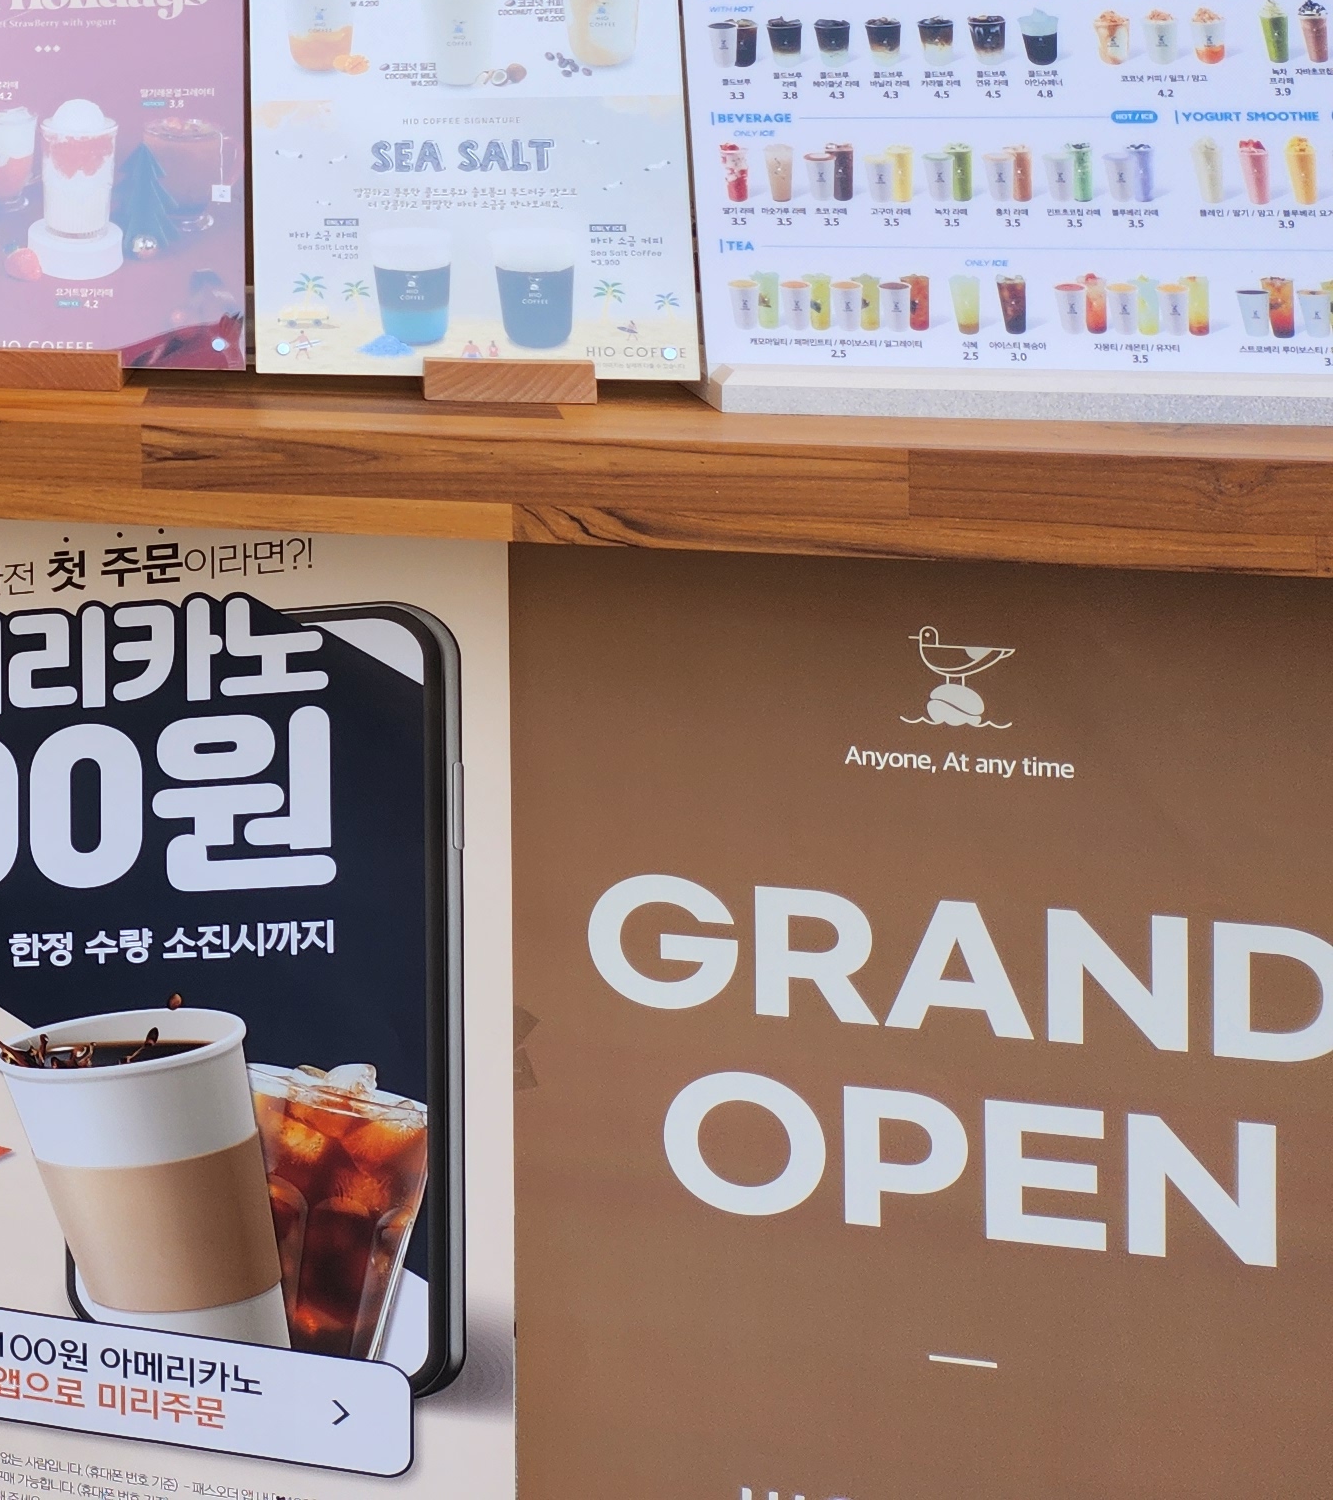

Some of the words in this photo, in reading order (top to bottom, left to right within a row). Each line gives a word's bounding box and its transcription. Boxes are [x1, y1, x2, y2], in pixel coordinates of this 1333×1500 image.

[718, 113, 791, 123] BEVERAGE
[1182, 112, 1242, 122] YOGURT
[1247, 111, 1319, 121] SMOOTHIE
[371, 140, 446, 172] SEA
[457, 138, 556, 172] SALT
[726, 241, 754, 251] TEA
[586, 346, 616, 357] HIO
[623, 346, 687, 358] COFE
[47, 550, 87, 591] 첫
[99, 537, 315, 588] 주문이라면?!
[845, 745, 937, 774] Anyone,
[942, 751, 970, 773] At
[975, 753, 1016, 780] any
[1022, 755, 1074, 779] time
[8, 933, 73, 966] 한정
[85, 928, 153, 964] 수량
[161, 918, 335, 961] 소진시까지
[588, 873, 1333, 1063] GRAND
[663, 1071, 1277, 1268] OPEN
[102, 1344, 264, 1397] 아메리카노
[97, 1384, 225, 1430] 미리주문
